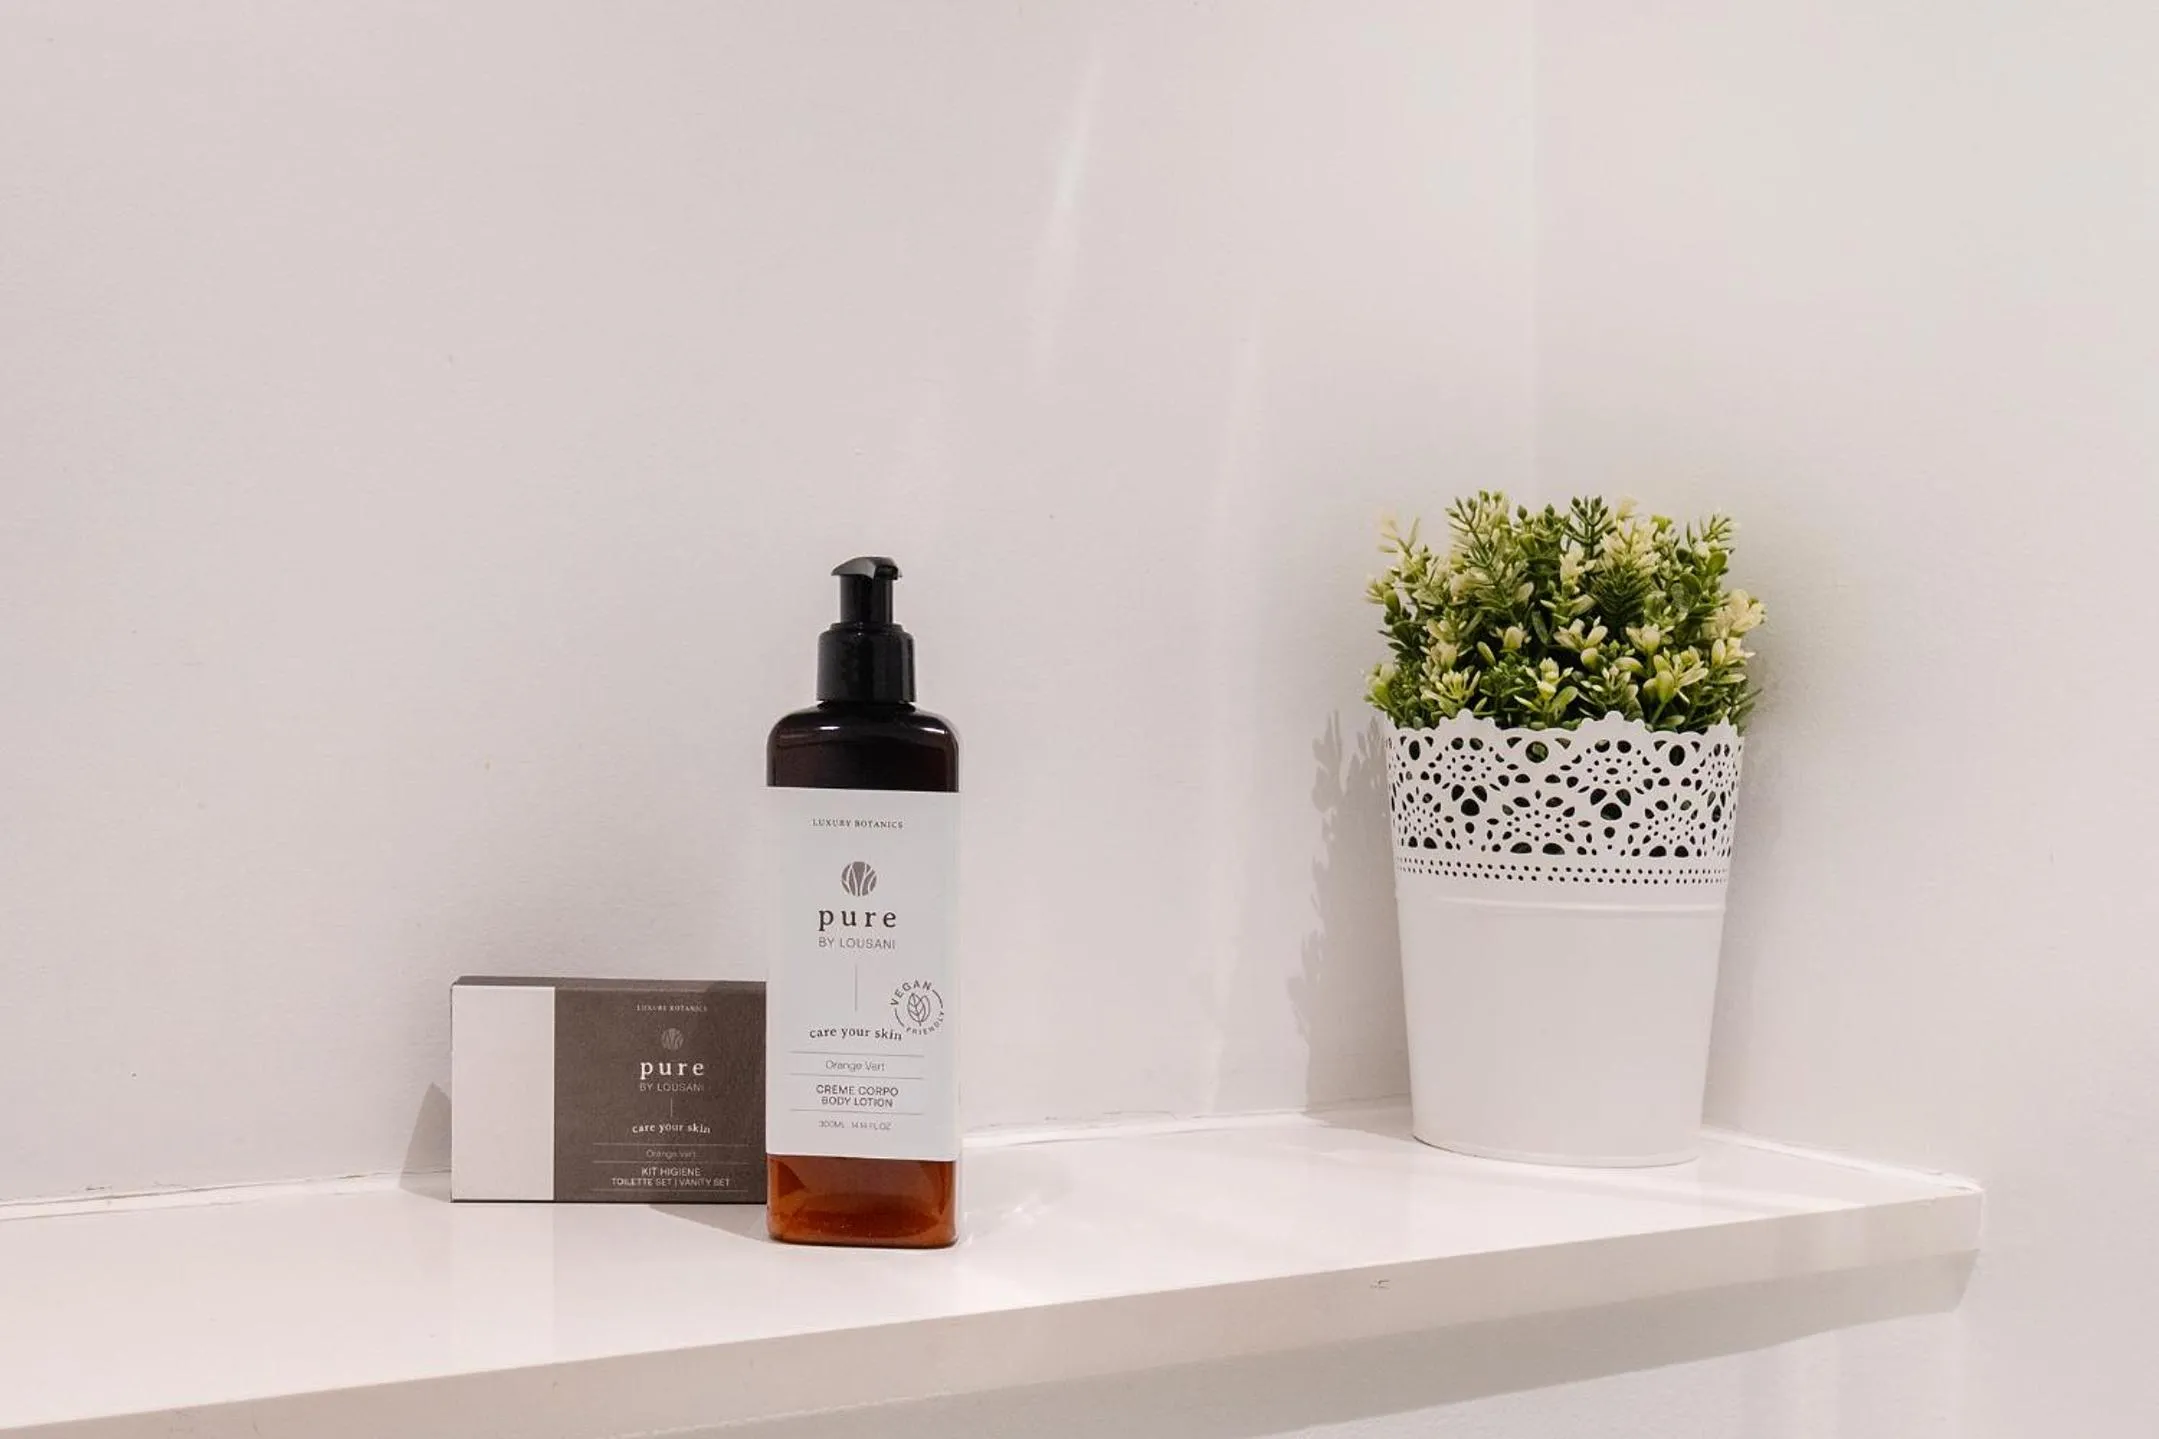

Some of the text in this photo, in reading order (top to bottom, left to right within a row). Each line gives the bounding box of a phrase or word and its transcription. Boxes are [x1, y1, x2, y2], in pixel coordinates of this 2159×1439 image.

[812, 819, 904, 829] LUXURY BOTANICS
[818, 909, 898, 932] pure
[818, 936, 896, 950] BY LOUSANI
[890, 979, 932, 1006] VEGAN
[906, 1010, 945, 1036] FRIENDLY
[809, 1027, 902, 1041] care your skin
[640, 1061, 705, 1081] pure
[825, 1060, 885, 1072] Orange Vert
[640, 1082, 705, 1093] BY LOUSANI
[815, 1084, 899, 1097] CREME CORPO
[821, 1096, 893, 1108] BODY LOTION
[632, 1122, 711, 1134] care your skin
[641, 1166, 701, 1177] KIT HIGIENE
[611, 1177, 653, 1187] TOILETTE
[655, 1178, 672, 1187] SET
[680, 1178, 712, 1187] VANITY
[714, 1178, 730, 1187] SET
